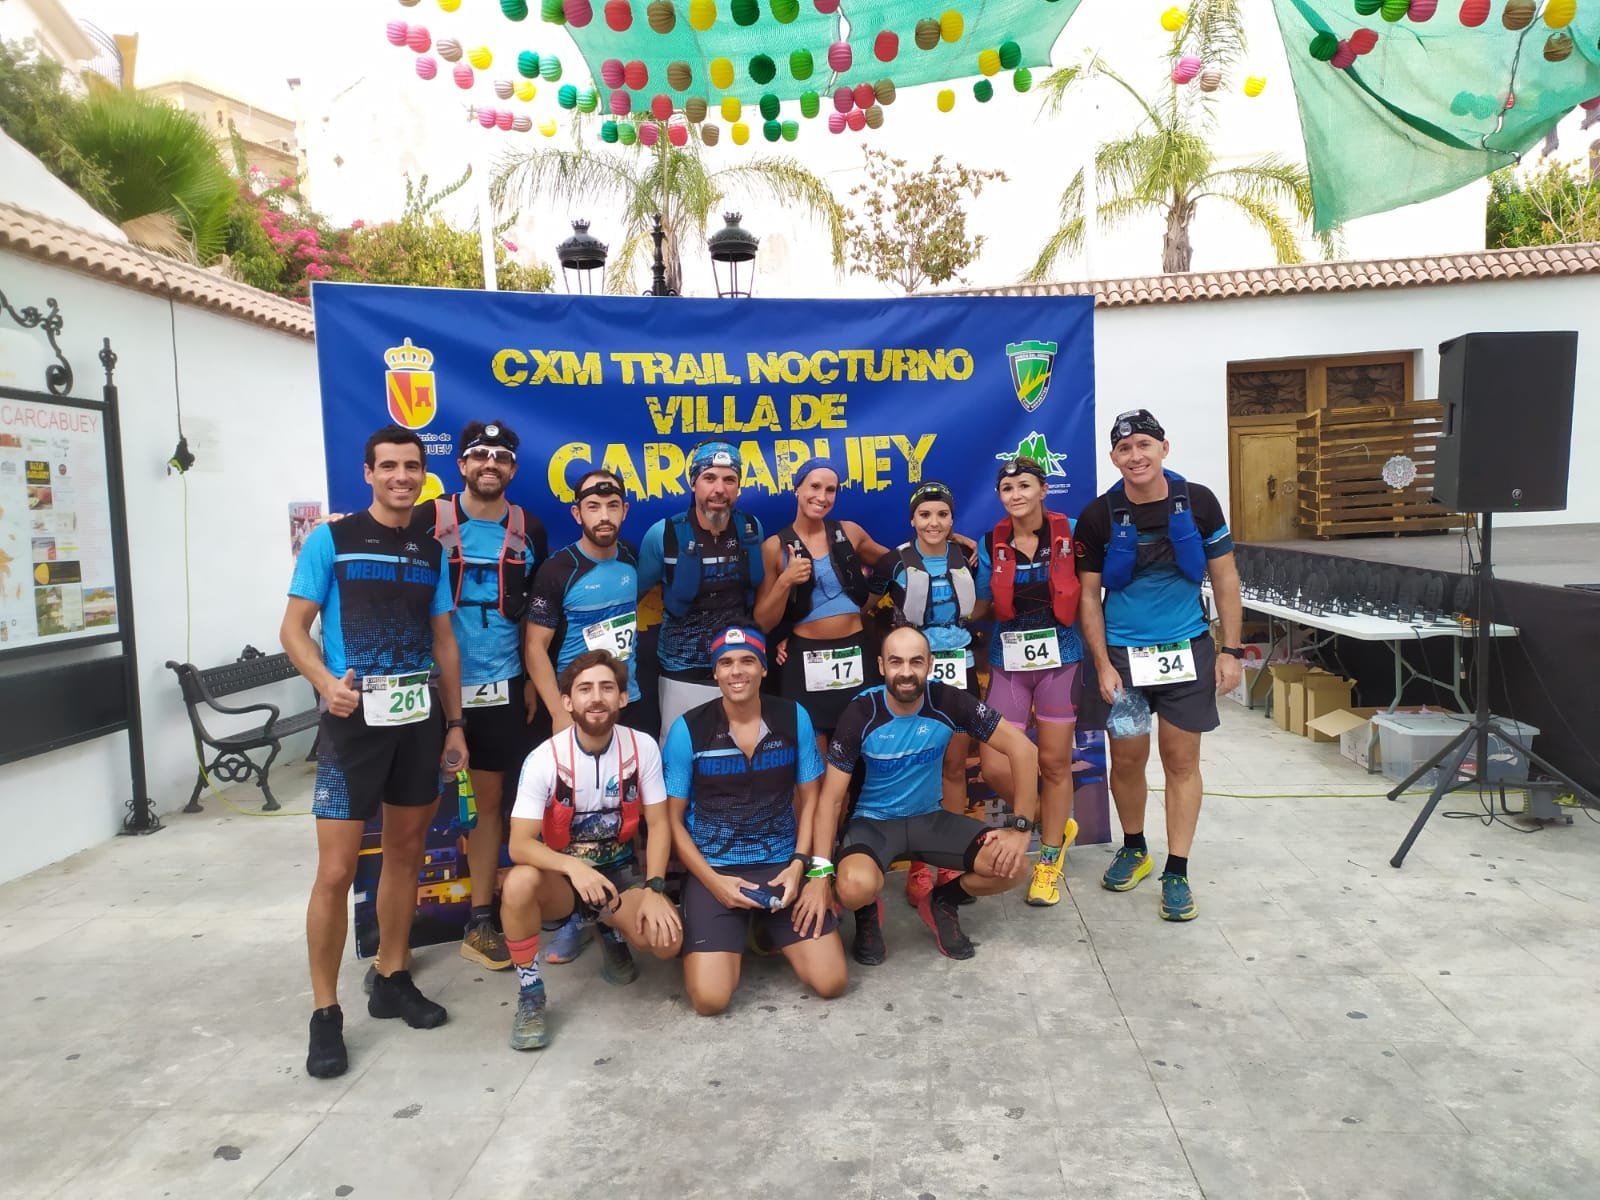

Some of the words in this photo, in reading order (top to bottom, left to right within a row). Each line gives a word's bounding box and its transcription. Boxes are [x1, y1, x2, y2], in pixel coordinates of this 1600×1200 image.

[491, 348, 603, 387] CXM
[611, 352, 742, 386] TRAIL
[747, 348, 974, 385] NOCTURNO
[1, 404, 98, 433] CARCABUEY
[646, 394, 782, 434] VILLA
[790, 393, 848, 430] DE
[345, 562, 397, 582] MEDIA
[614, 628, 633, 650] 52
[1024, 642, 1050, 661] 64
[831, 661, 853, 680] 17
[933, 662, 957, 680] 58
[1158, 654, 1185, 675] 34
[389, 687, 426, 713] 261
[699, 756, 747, 777] MEDIA
